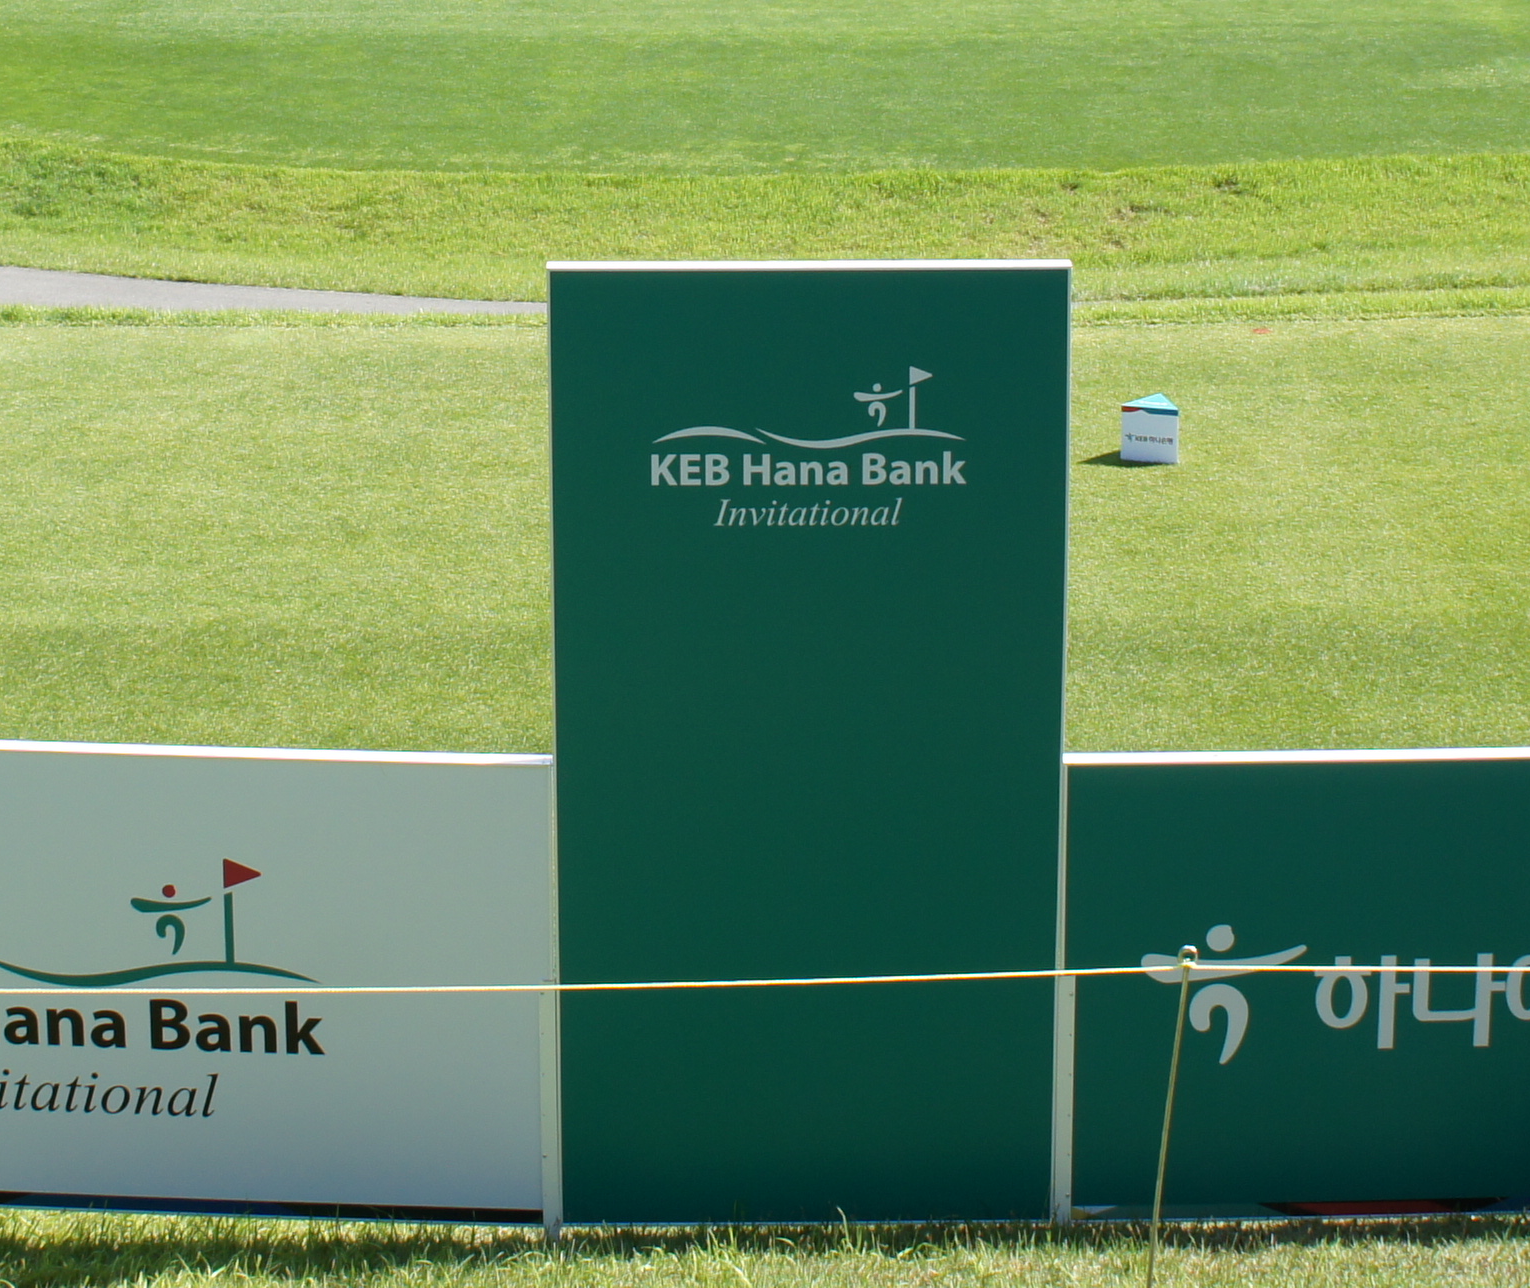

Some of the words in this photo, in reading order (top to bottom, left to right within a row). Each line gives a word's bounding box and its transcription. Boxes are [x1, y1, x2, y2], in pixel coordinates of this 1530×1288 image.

[649, 453, 731, 487] KEB
[742, 453, 849, 486] Hana
[861, 450, 967, 486] Bank
[712, 497, 904, 527] Invitational
[149, 998, 326, 1056] Bank
